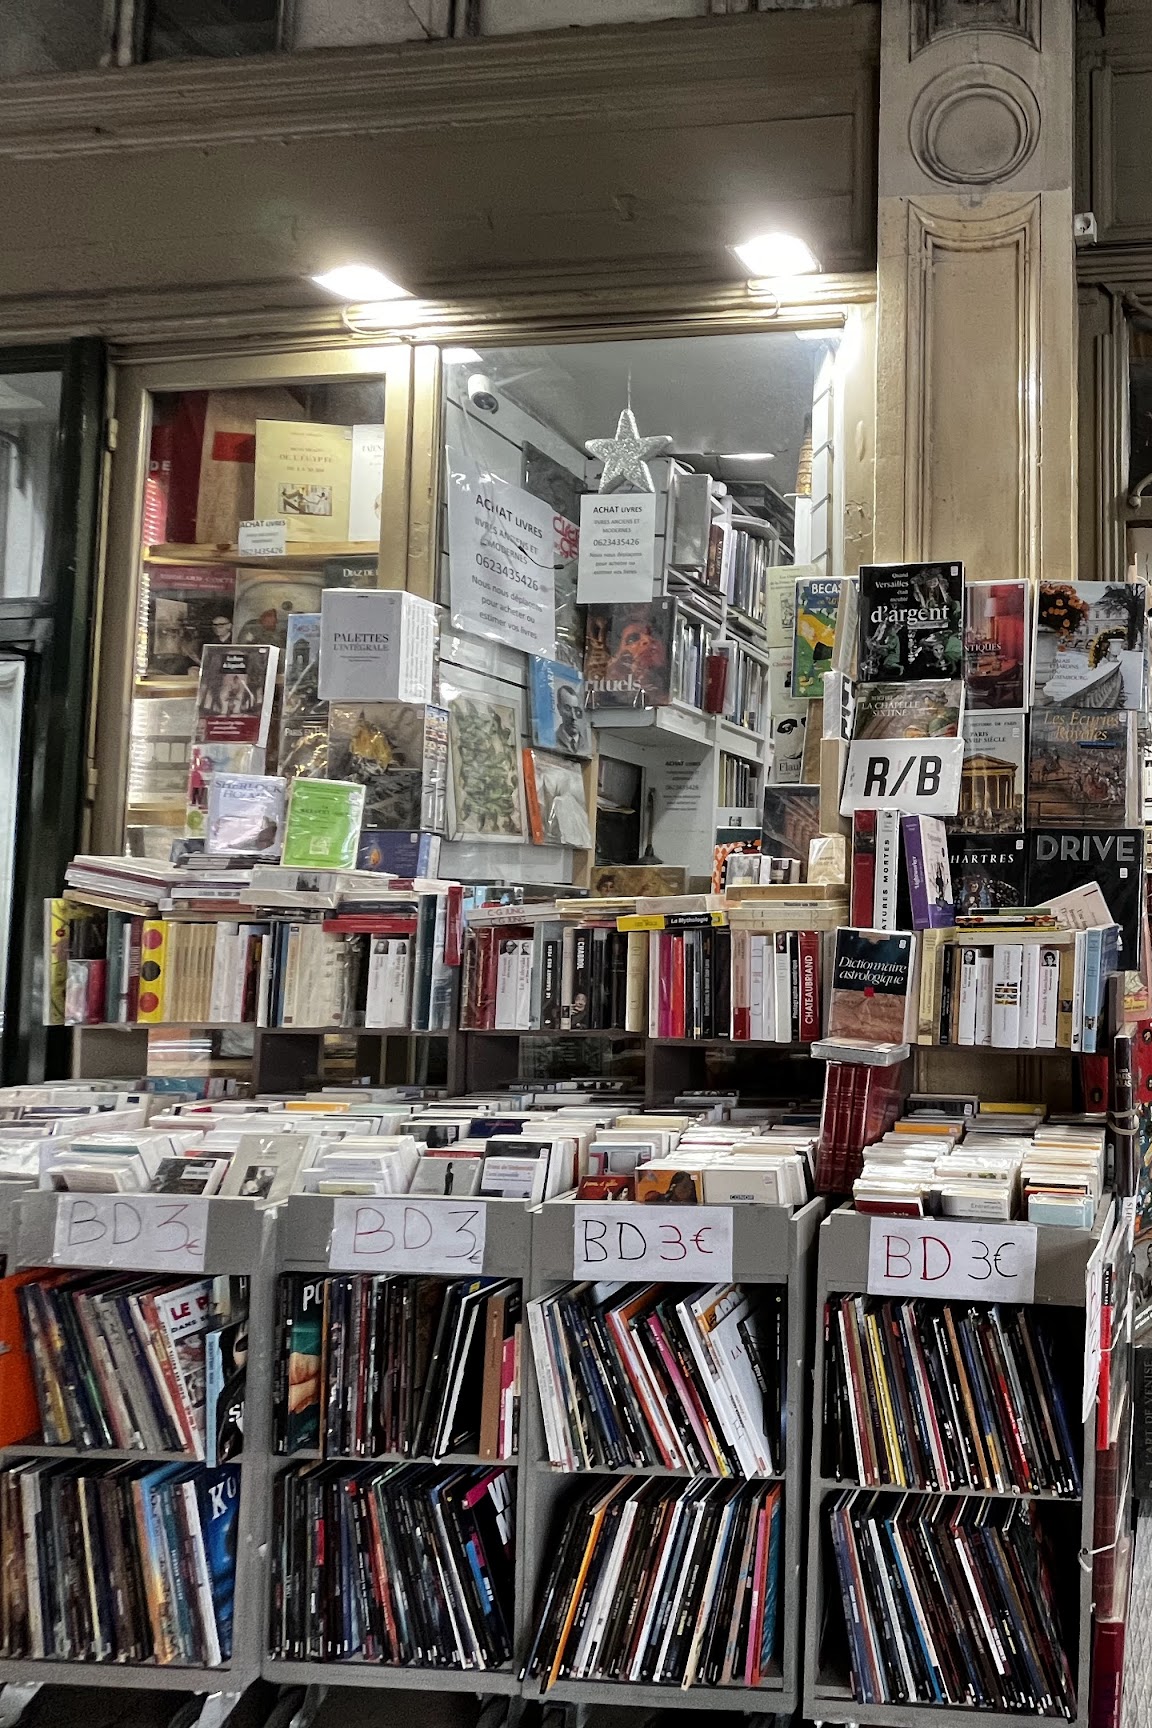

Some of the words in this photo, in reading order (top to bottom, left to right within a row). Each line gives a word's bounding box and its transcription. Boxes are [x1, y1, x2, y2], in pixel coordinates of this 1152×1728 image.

[474, 494, 513, 524] ACHAT
[514, 515, 543, 540] LIVRES
[593, 506, 619, 514] ACHAT
[620, 506, 643, 514] LIVRES
[241, 520, 265, 528] ACHAT
[593, 538, 640, 547] 0623435426
[471, 574, 492, 591] Nous
[475, 553, 539, 592] 0623435426
[875, 580, 909, 590] Versailles
[871, 603, 950, 624] d'argent
[333, 633, 389, 643] PALETTES
[965, 641, 1002, 653] NTIQUES
[584, 673, 642, 693] rituels
[862, 755, 943, 797] R/B
[951, 853, 1015, 864] HARTRES
[1036, 835, 1136, 863] DRIVE
[883, 838, 891, 884] MORTES
[881, 888, 890, 931] ATURES
[838, 956, 908, 975] Dictionnaire
[838, 969, 905, 986] astrologique
[803, 953, 814, 1025] CHATEAUBRIAND
[68, 1199, 143, 1247] BD
[353, 1207, 433, 1255] BD
[582, 1218, 648, 1263] BD
[658, 1223, 714, 1262] 3€
[882, 1234, 952, 1282] BD
[967, 1239, 1018, 1281] 3€
[170, 1302, 192, 1321] LE
